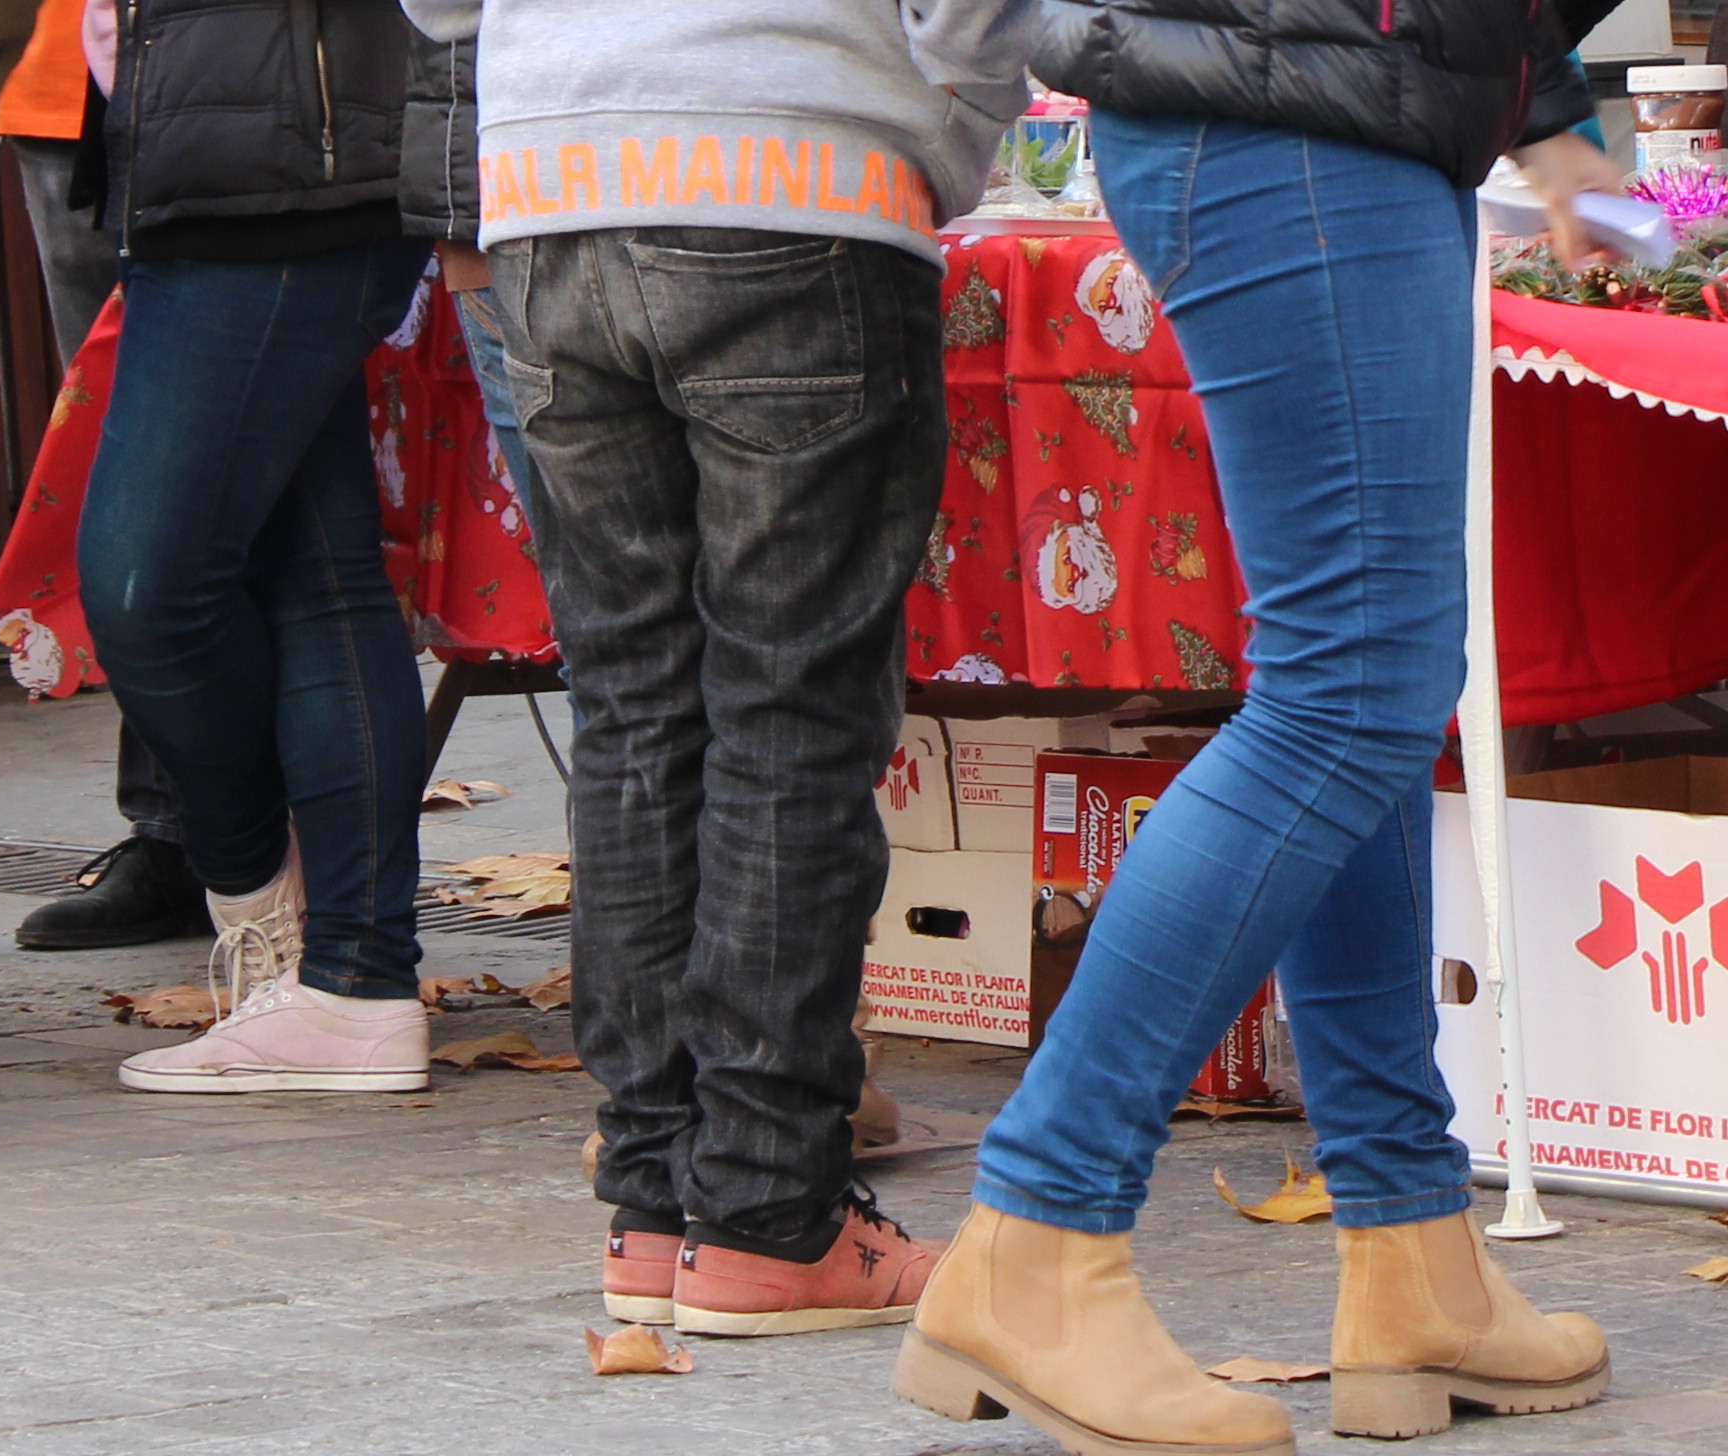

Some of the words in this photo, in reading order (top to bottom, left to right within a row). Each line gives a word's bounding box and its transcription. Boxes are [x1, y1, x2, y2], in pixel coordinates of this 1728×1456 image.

[975, 748, 983, 760] P.
[962, 787, 1003, 802] QUANT.
[1112, 811, 1121, 821] A
[1079, 810, 1088, 869] tradicional
[1086, 786, 1110, 894] Chocolate
[1112, 823, 1121, 840] LA
[862, 961, 906, 981] MERCAT
[910, 967, 927, 983] DE
[931, 970, 963, 988] FLOR
[966, 974, 971, 987] I
[974, 974, 1027, 993] PLANTA
[862, 981, 948, 1004] ORNAMENTAL
[951, 990, 968, 1005] DE
[1227, 1010, 1243, 1091] ocolate
[1608, 1105, 1642, 1130] DE
[1650, 1110, 1714, 1139] FLOR
[1721, 1118, 1728, 1141] I
[1685, 1159, 1720, 1182] DE
